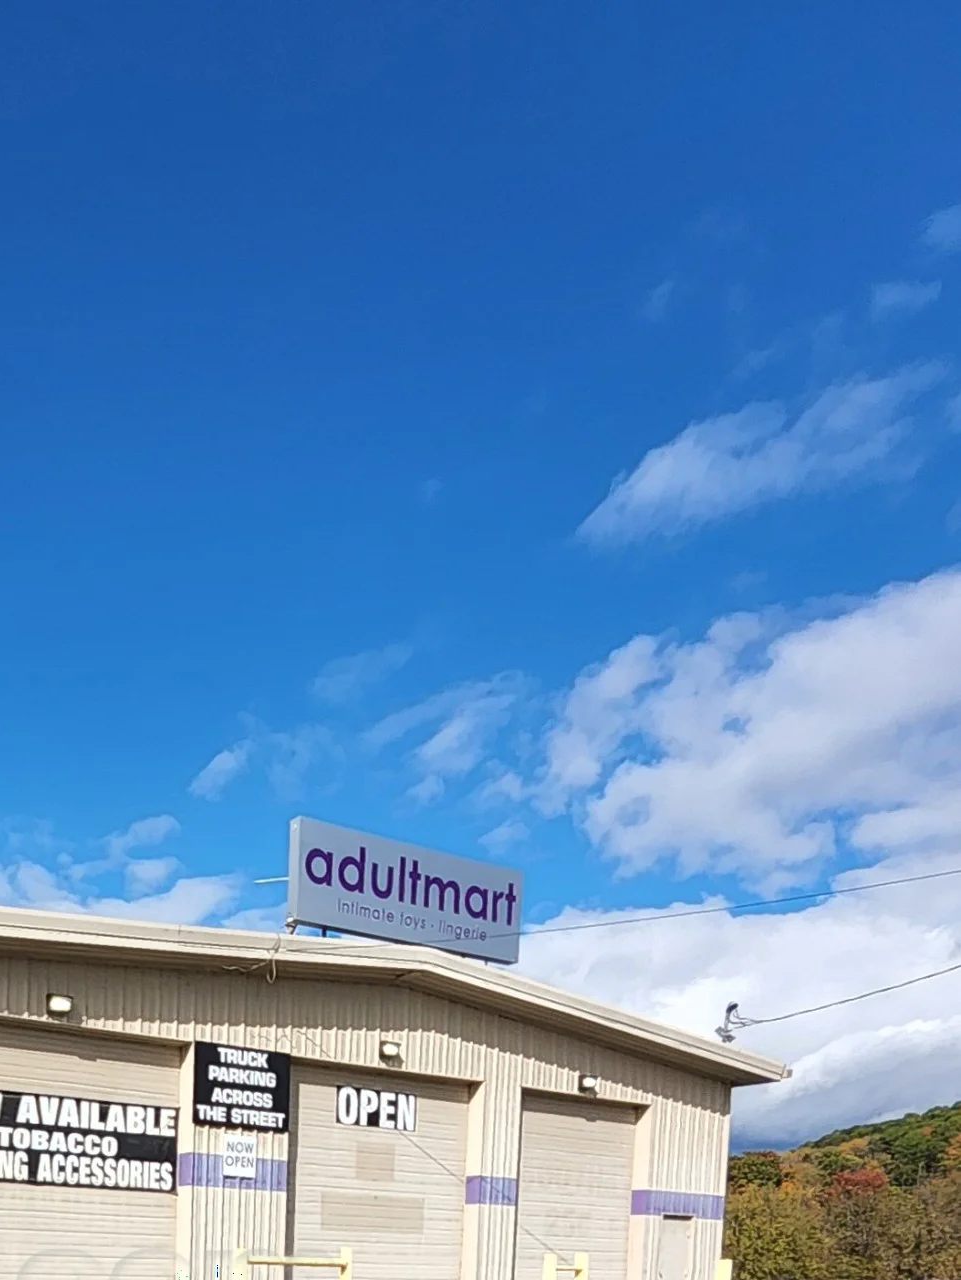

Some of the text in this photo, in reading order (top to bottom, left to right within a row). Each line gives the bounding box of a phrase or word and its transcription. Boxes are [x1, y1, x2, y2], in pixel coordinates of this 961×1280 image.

[305, 847, 516, 926] adultmart
[338, 898, 487, 941] intimate toys lingerie
[217, 1047, 268, 1069] TRUCK
[208, 1065, 277, 1088] PARKING
[211, 1087, 273, 1109] ACROSS
[338, 1086, 416, 1132] OPEN
[16, 1095, 176, 1137] AVAILABLE
[196, 1104, 285, 1129] THE STREET
[226, 1141, 254, 1154] NOW
[36, 1153, 173, 1191] ACCESSORIES
[225, 1155, 254, 1169] OPEN
